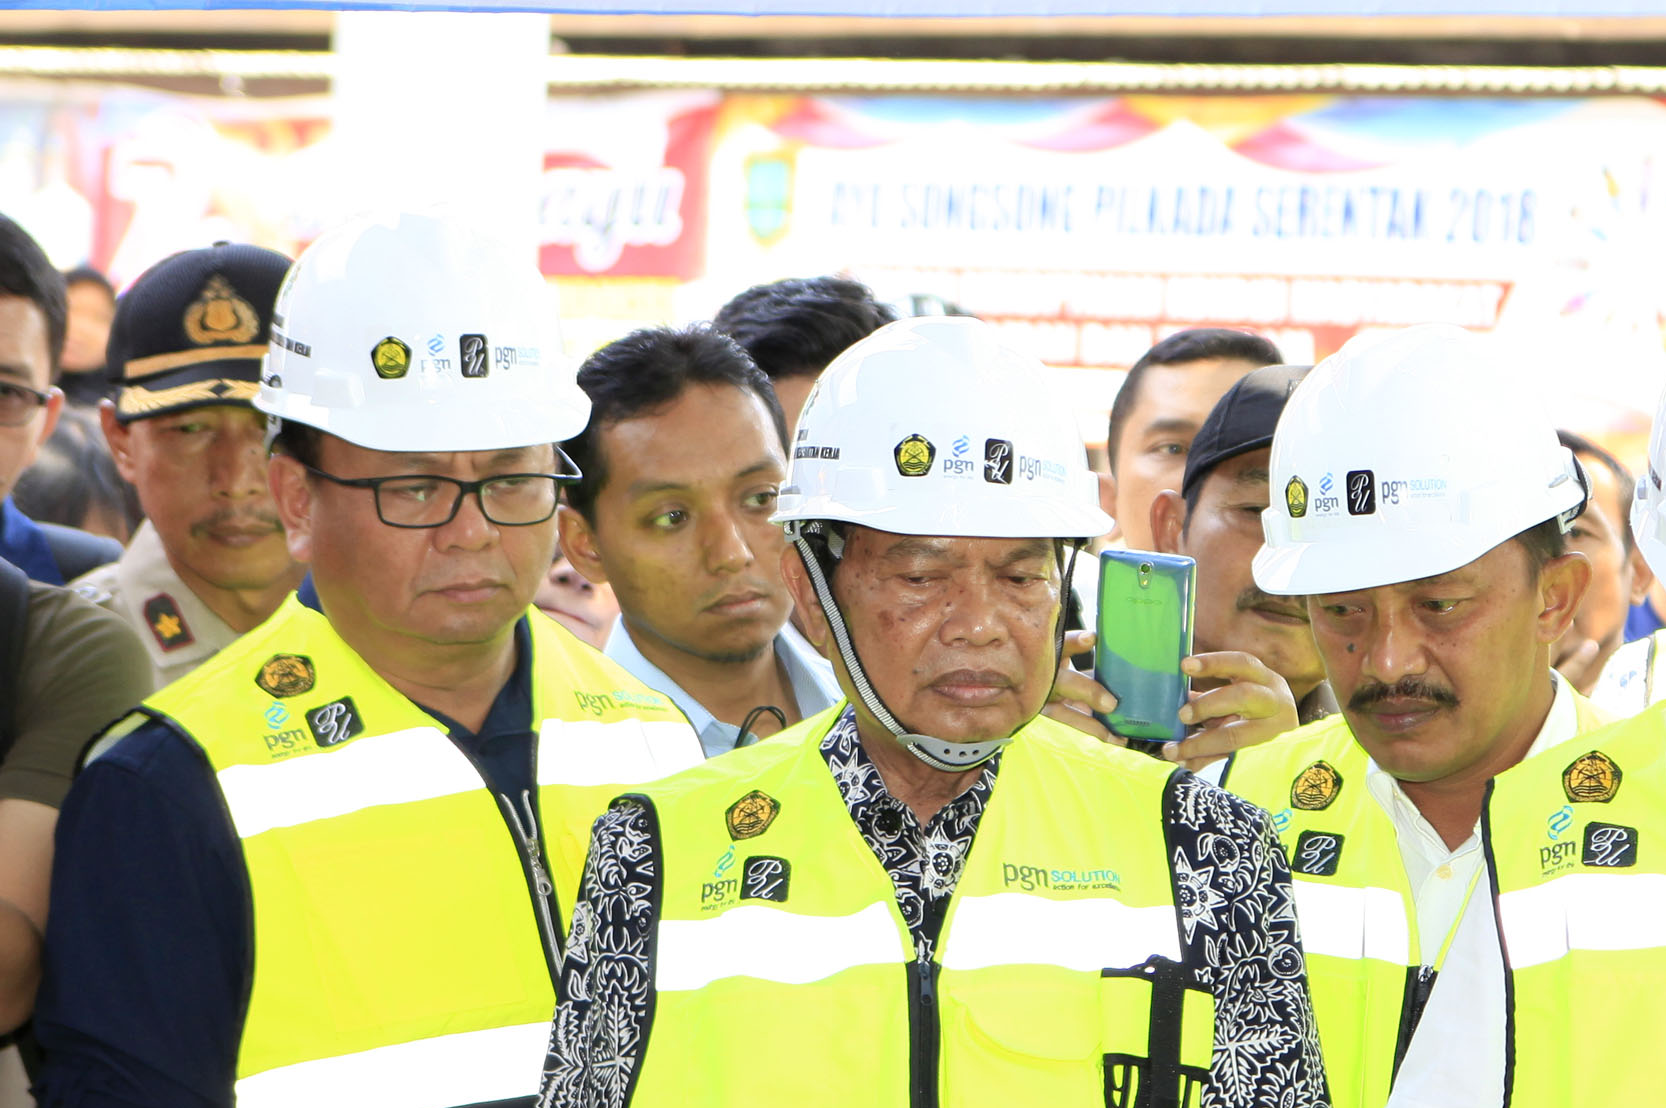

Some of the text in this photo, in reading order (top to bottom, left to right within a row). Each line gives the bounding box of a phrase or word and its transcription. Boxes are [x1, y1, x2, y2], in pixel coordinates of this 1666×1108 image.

[1251, 183, 1431, 241] SERENTAK
[1445, 187, 1538, 245] 2018
[494, 345, 518, 370] pgn
[943, 458, 975, 474] pgn
[1019, 455, 1042, 481] pgn
[1314, 497, 1339, 512] pgn
[1381, 480, 1408, 505] pgn
[575, 691, 616, 716] pgn
[263, 728, 306, 751] pgn
[1540, 841, 1576, 869] pgn
[1002, 862, 1121, 891] pgn SOLUTION
[701, 879, 738, 903] pgn
